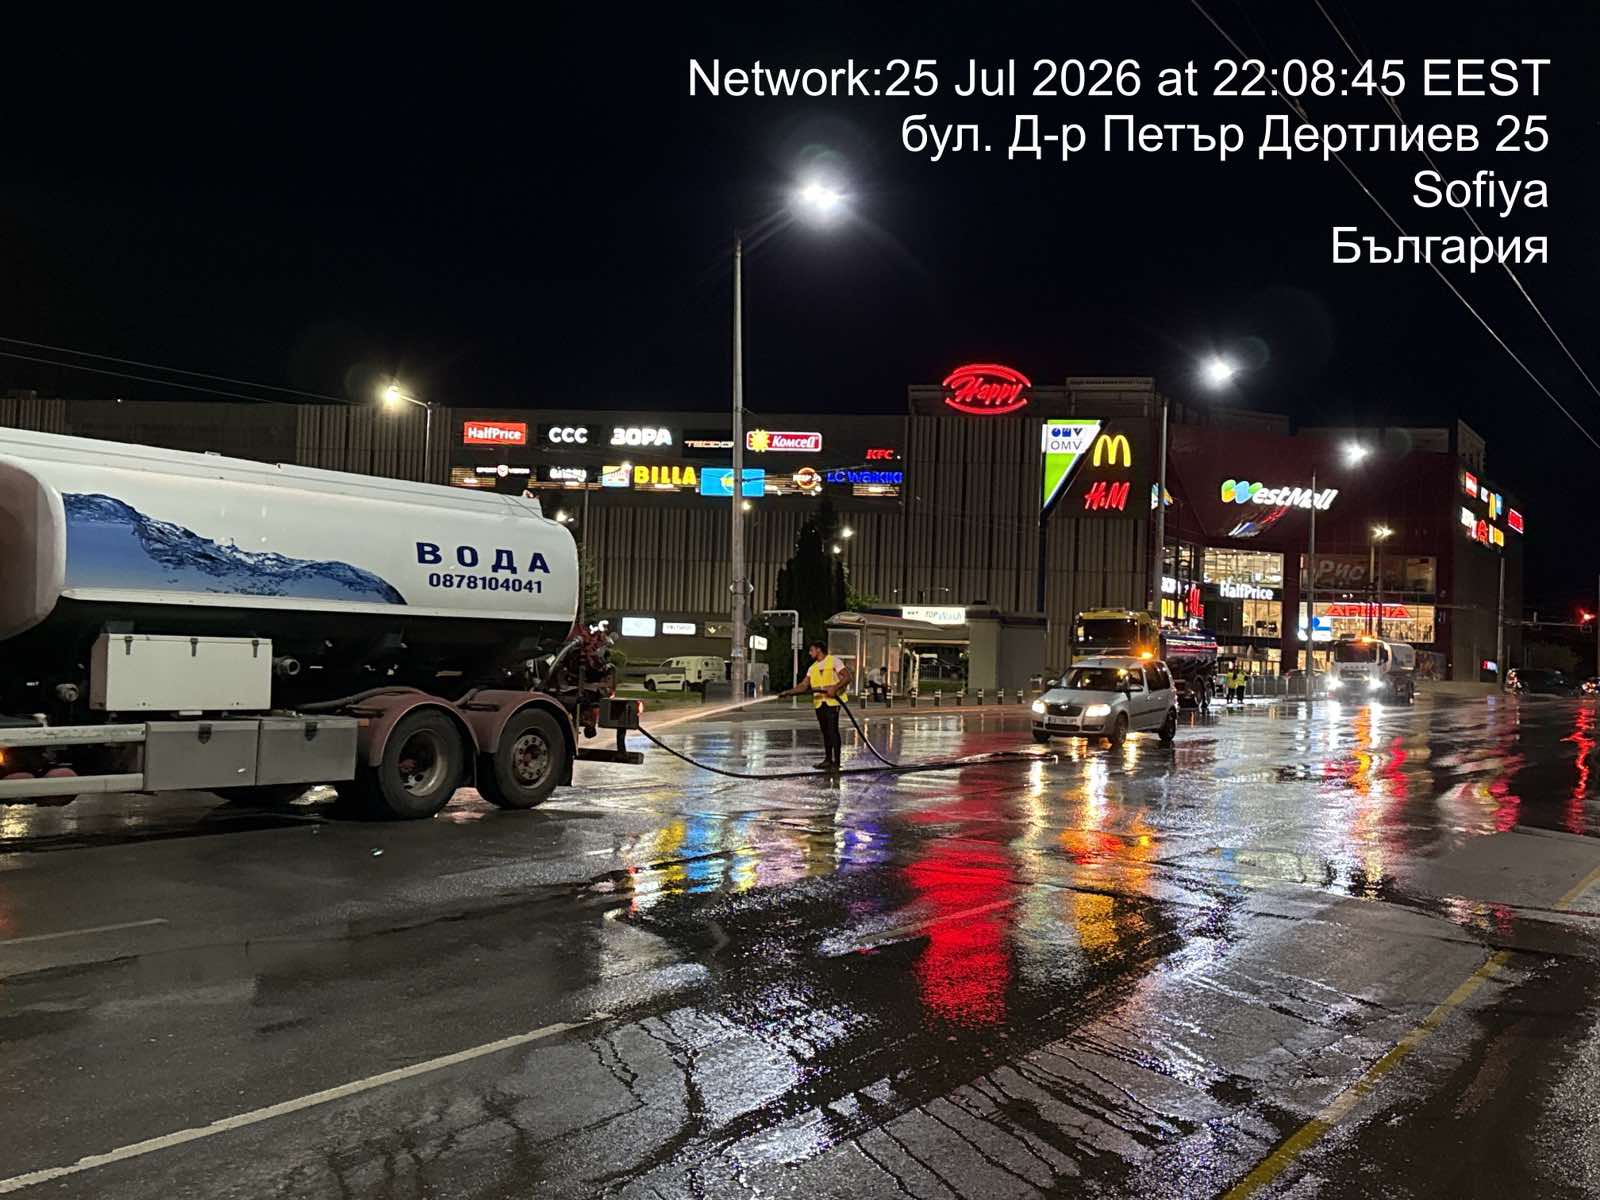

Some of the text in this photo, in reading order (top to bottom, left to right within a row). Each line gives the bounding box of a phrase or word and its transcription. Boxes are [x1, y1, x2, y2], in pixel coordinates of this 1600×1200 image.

[951, 375, 1023, 405] Happy
[467, 427, 522, 441] HalfPrice
[549, 427, 588, 444] CCC
[610, 427, 673, 446] ЗОРА
[866, 449, 894, 460] KFC
[1050, 440, 1083, 450] OMV
[633, 465, 697, 485] BILLA
[416, 541, 551, 575] ВОДА
[428, 573, 543, 594] 0878104041
[1220, 581, 1274, 600] HalfPrice
